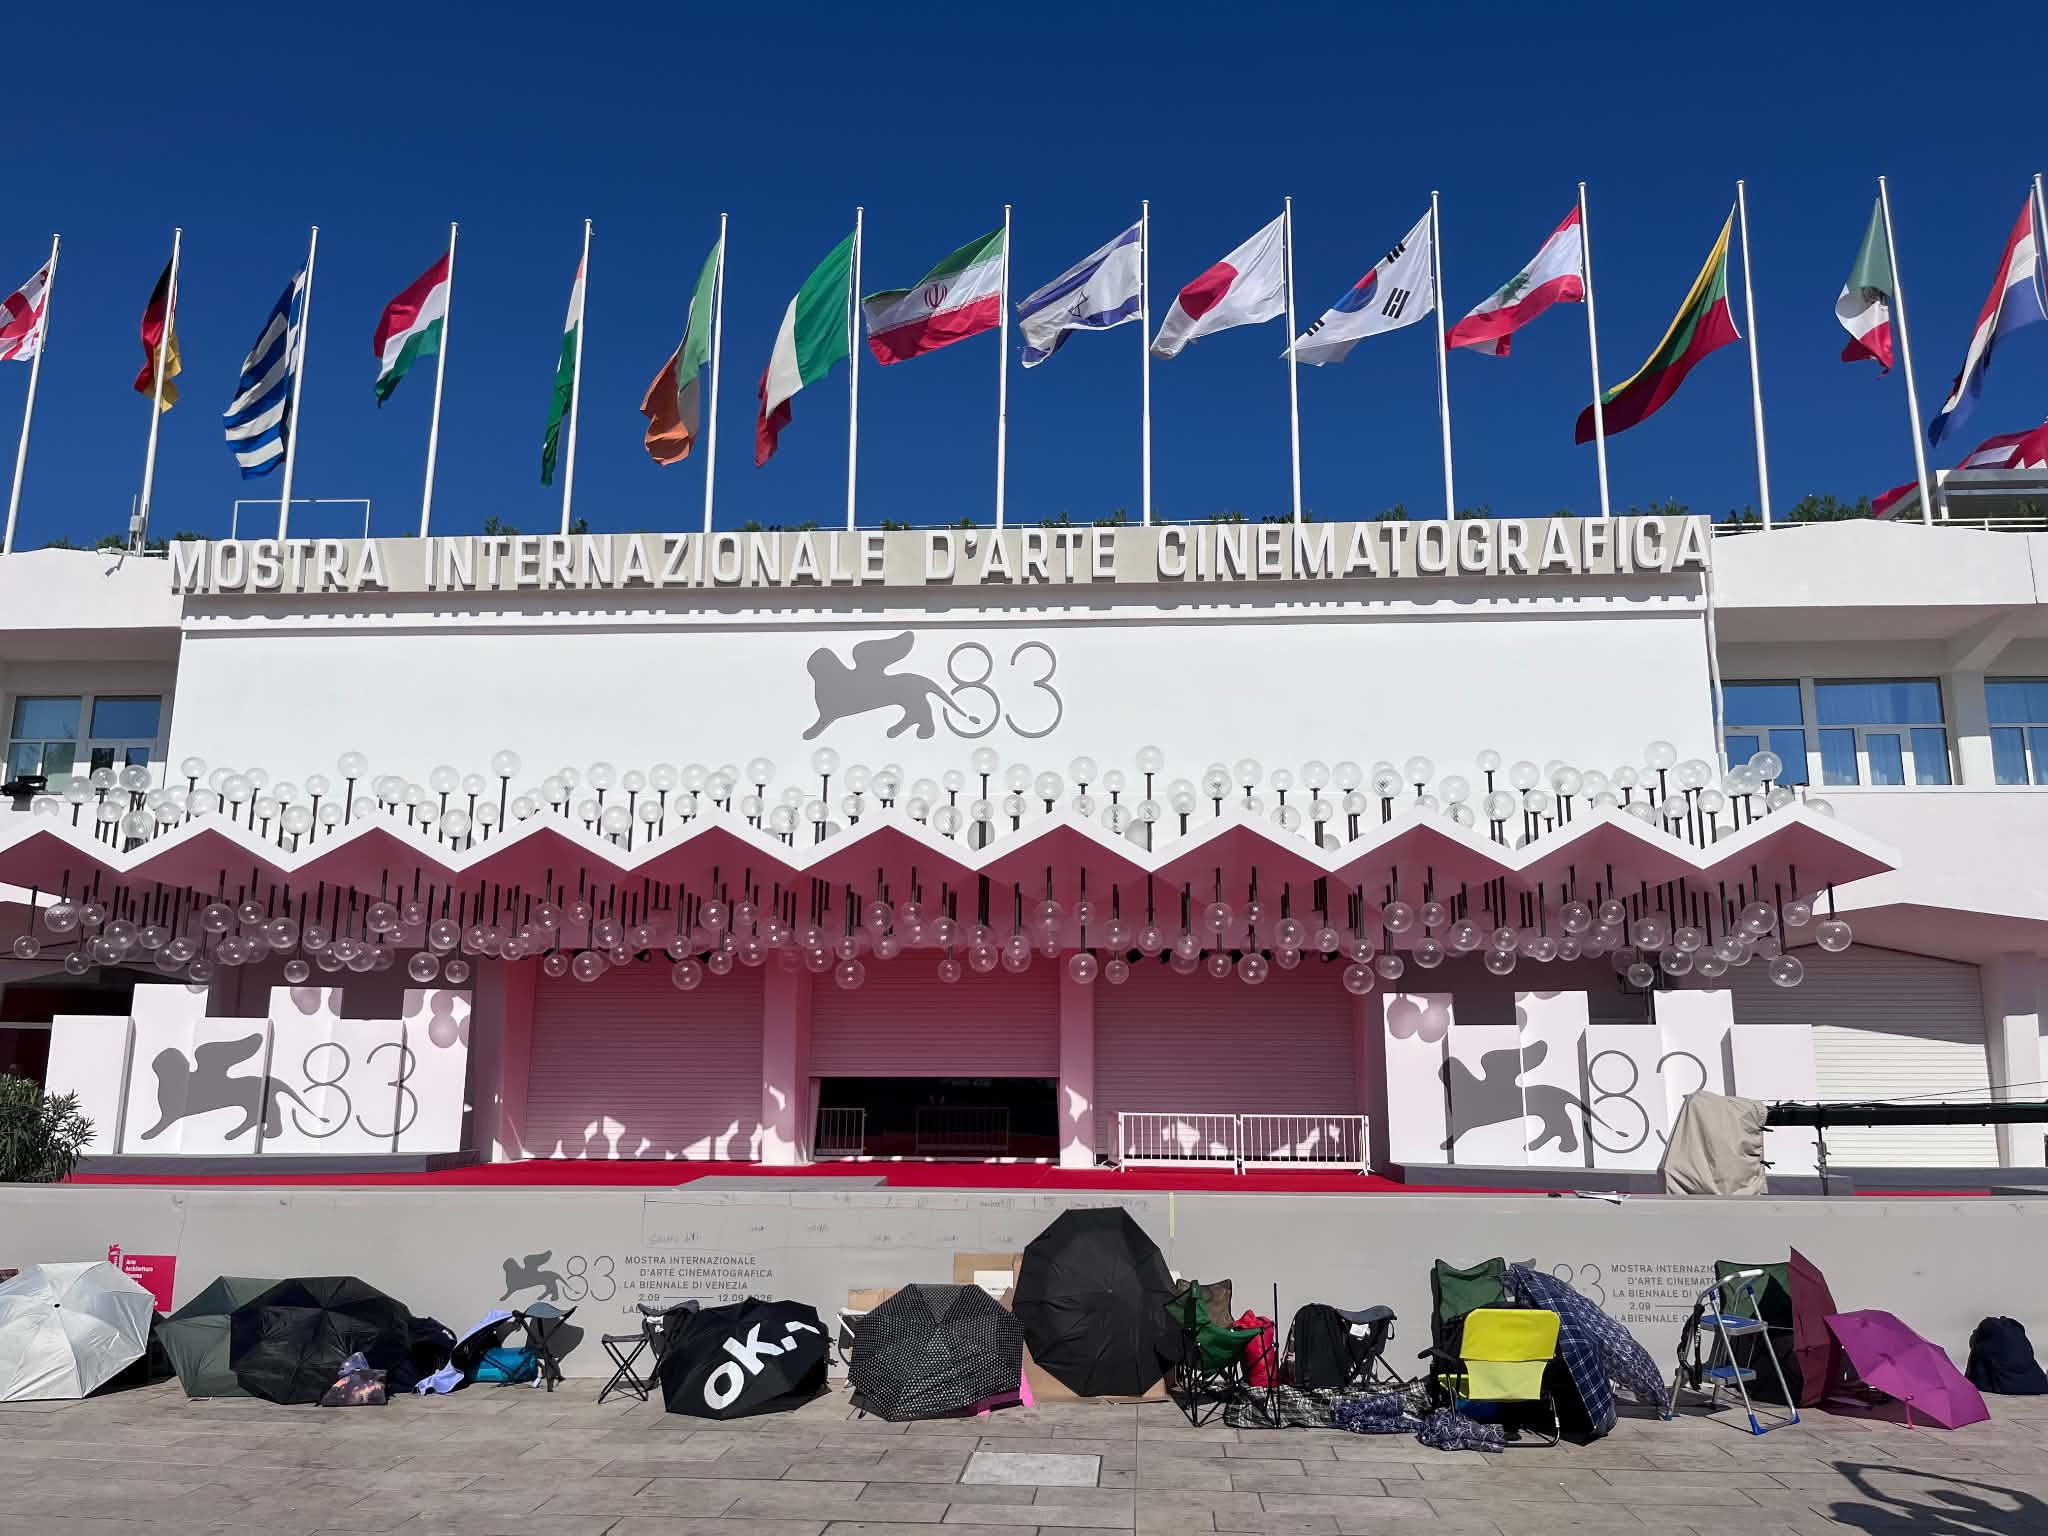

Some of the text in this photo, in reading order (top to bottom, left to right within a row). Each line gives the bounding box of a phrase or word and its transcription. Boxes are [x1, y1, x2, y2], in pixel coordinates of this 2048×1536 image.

[168, 516, 1711, 591] MOSTRA INTERNAZIONALE D'ARTE CINEMATOGRAFICA
[943, 641, 1063, 739] 83
[292, 1042, 418, 1138] 83
[625, 1256, 756, 1265] MOSTRA INTERNAZIONALE
[640, 1268, 773, 1278] D'ARTE CINEMATOGRAFICA
[1611, 1264, 1653, 1273] MOSTRA
[562, 1255, 617, 1301] 83
[1627, 1277, 1715, 1286] D'ARTE CINEMAT
[623, 1280, 748, 1290] LA BIENNALE DI VENEZIA
[1612, 1289, 1625, 1298] LA
[1628, 1289, 1678, 1298] BIENNALE
[1682, 1289, 1692, 1298] DI
[1629, 1302, 1651, 1310] 2.09
